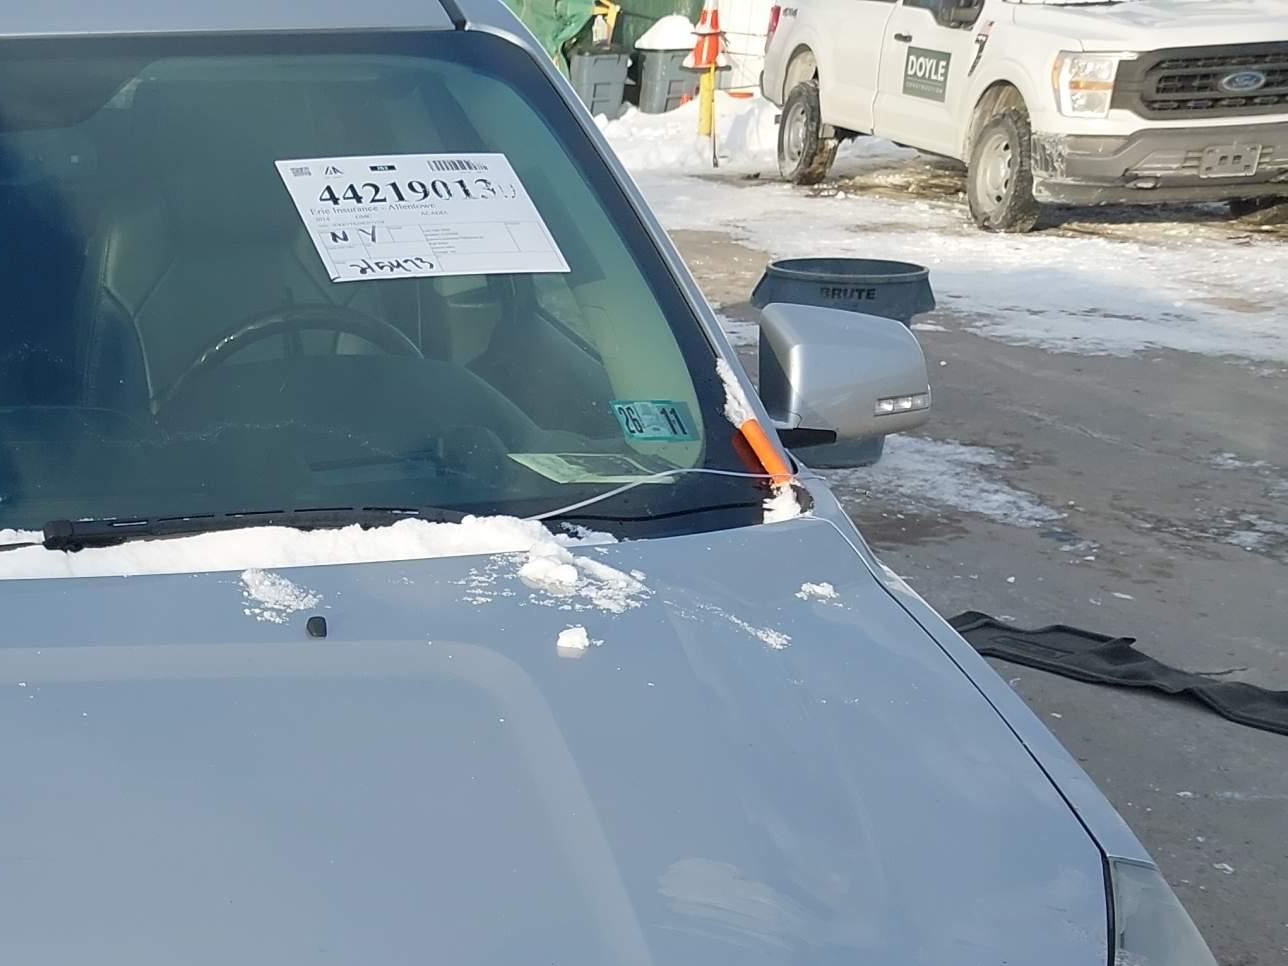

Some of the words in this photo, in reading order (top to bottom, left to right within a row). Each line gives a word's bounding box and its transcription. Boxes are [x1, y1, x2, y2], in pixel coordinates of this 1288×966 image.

[907, 55, 947, 82] DOYLE
[330, 230, 349, 243] N
[358, 225, 376, 243] Y
[819, 287, 877, 300] BRUTE
[617, 406, 644, 434] 26
[659, 407, 688, 435] 11
